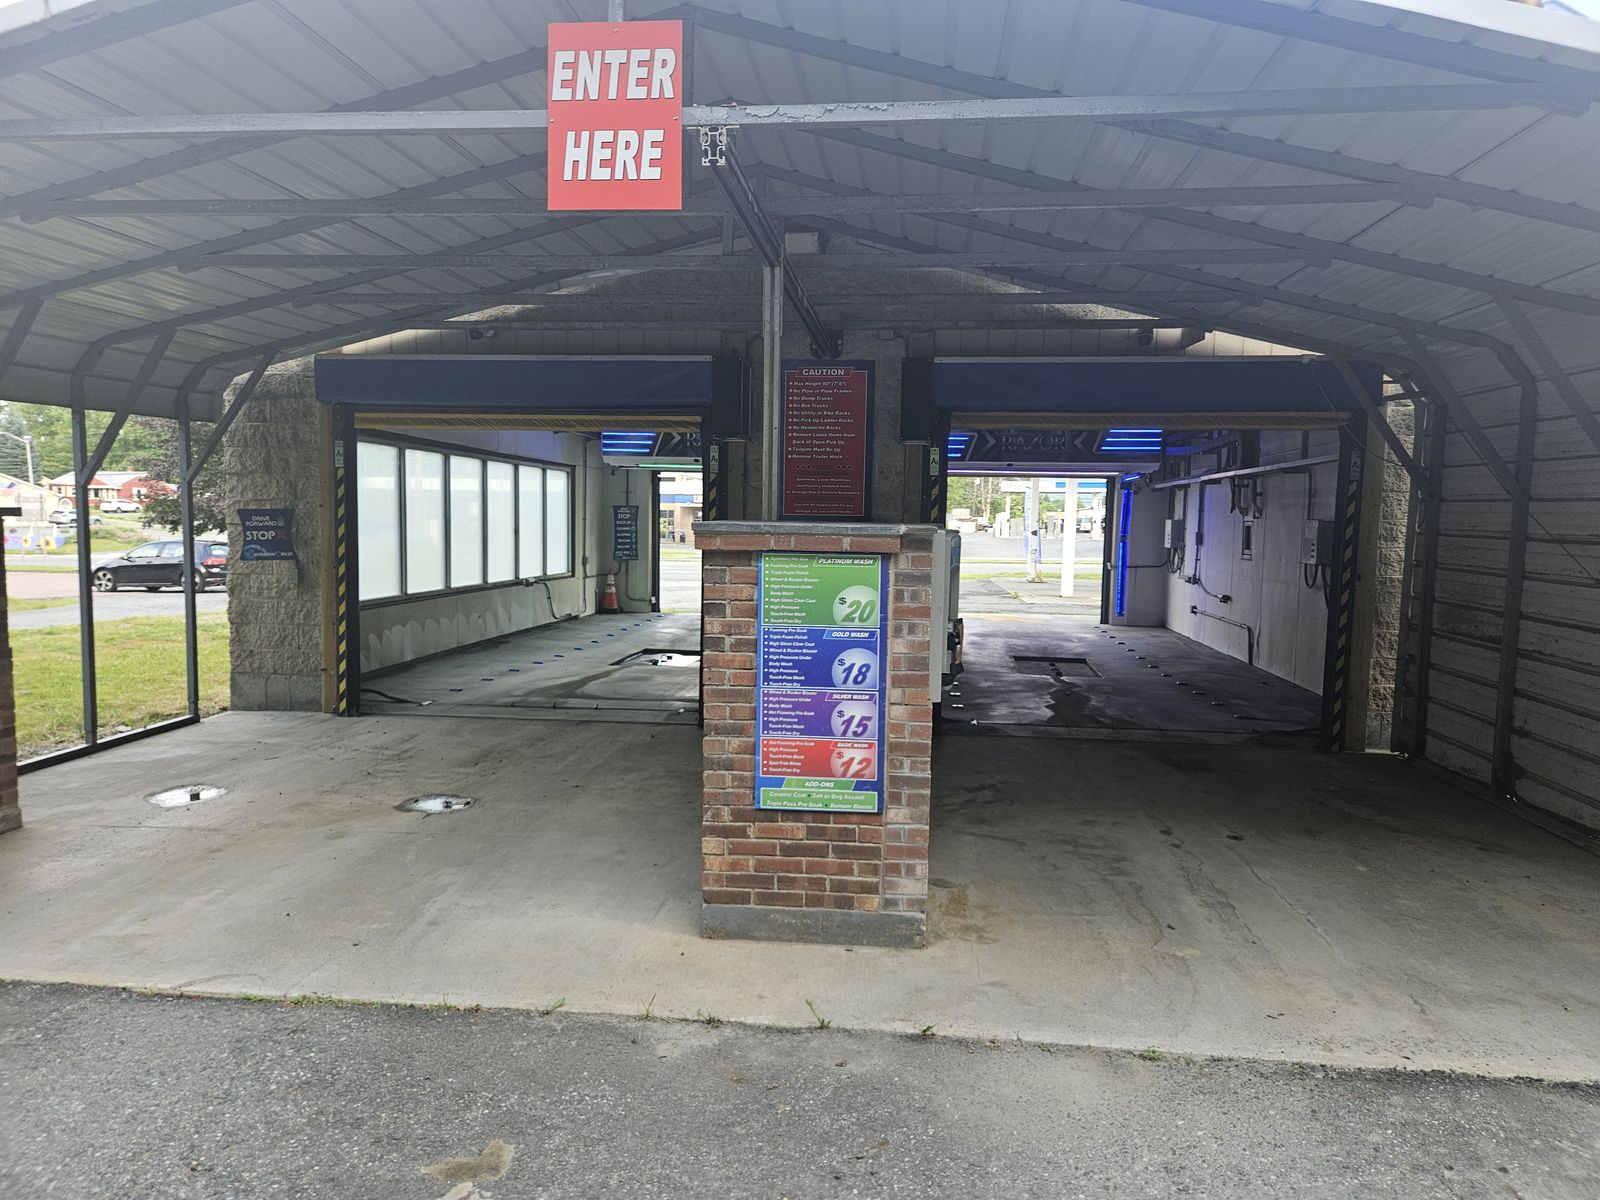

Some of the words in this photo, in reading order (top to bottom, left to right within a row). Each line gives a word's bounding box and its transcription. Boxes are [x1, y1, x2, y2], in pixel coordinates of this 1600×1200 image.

[552, 48, 676, 101] ENTER
[563, 130, 664, 181] HERE
[802, 368, 845, 376] CAUTION
[246, 530, 276, 540] STOP
[838, 597, 876, 623] $20
[838, 658, 871, 685] $18
[837, 710, 873, 737] $15
[836, 751, 873, 778] $12
